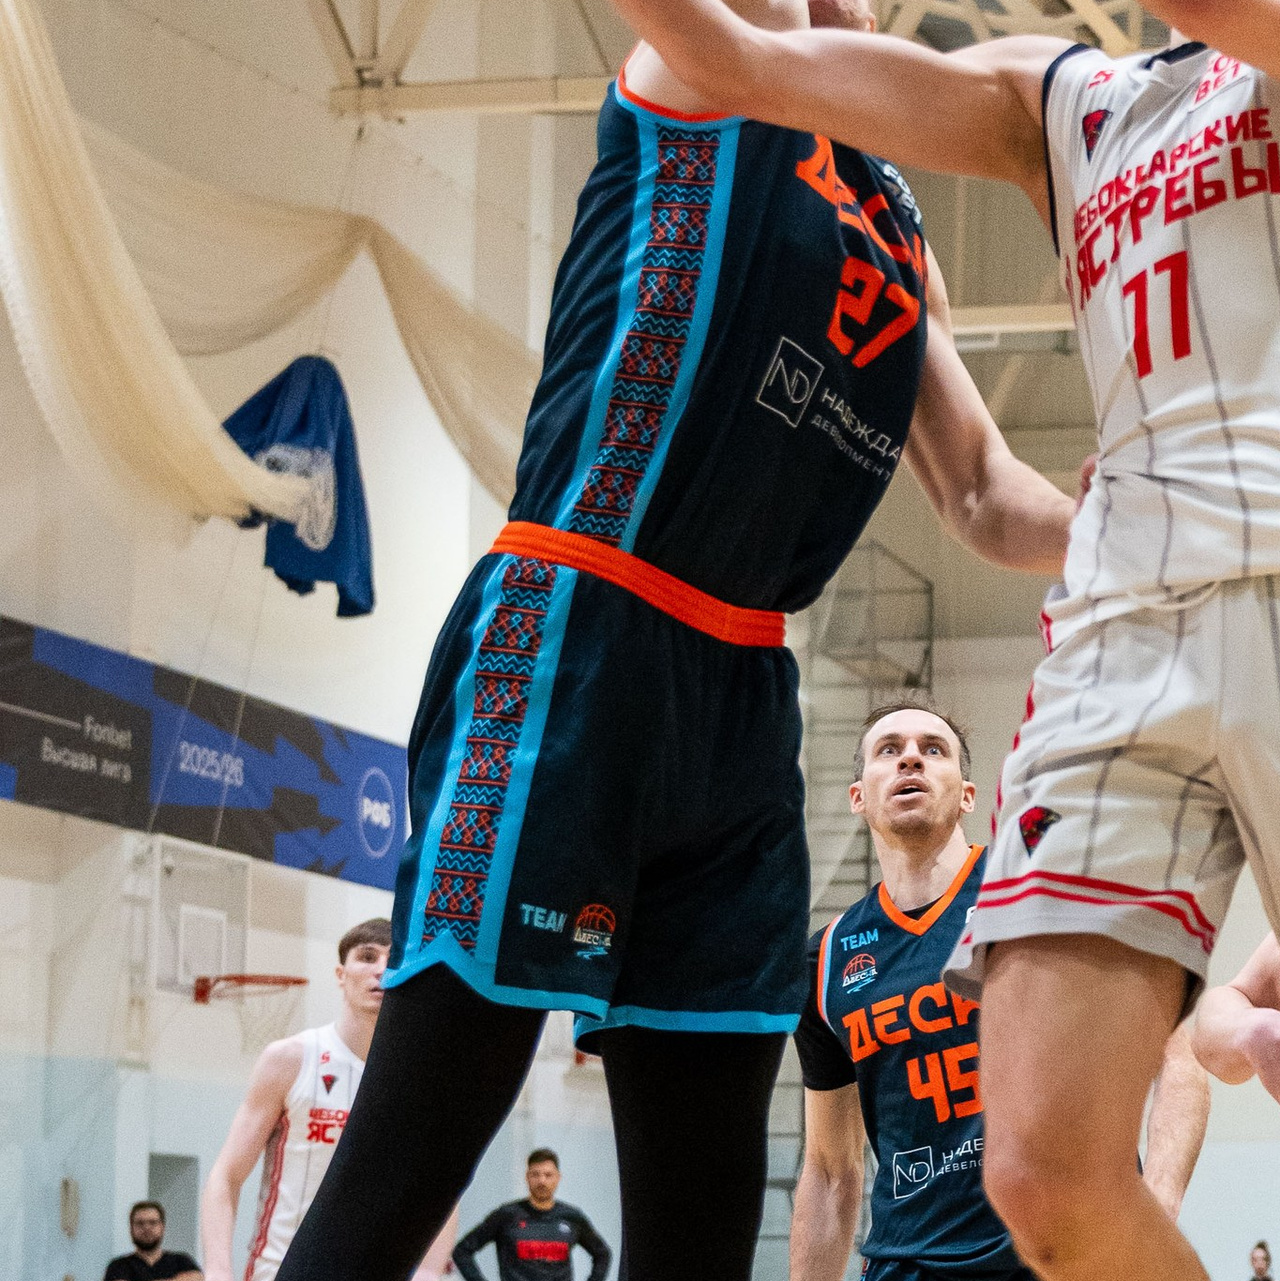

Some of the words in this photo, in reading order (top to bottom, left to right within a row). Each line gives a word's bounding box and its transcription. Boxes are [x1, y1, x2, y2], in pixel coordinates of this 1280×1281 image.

[826, 255, 921, 369] 27
[1122, 250, 1192, 380] 11
[840, 928, 879, 952] TEAM
[906, 1042, 985, 1124] 45
